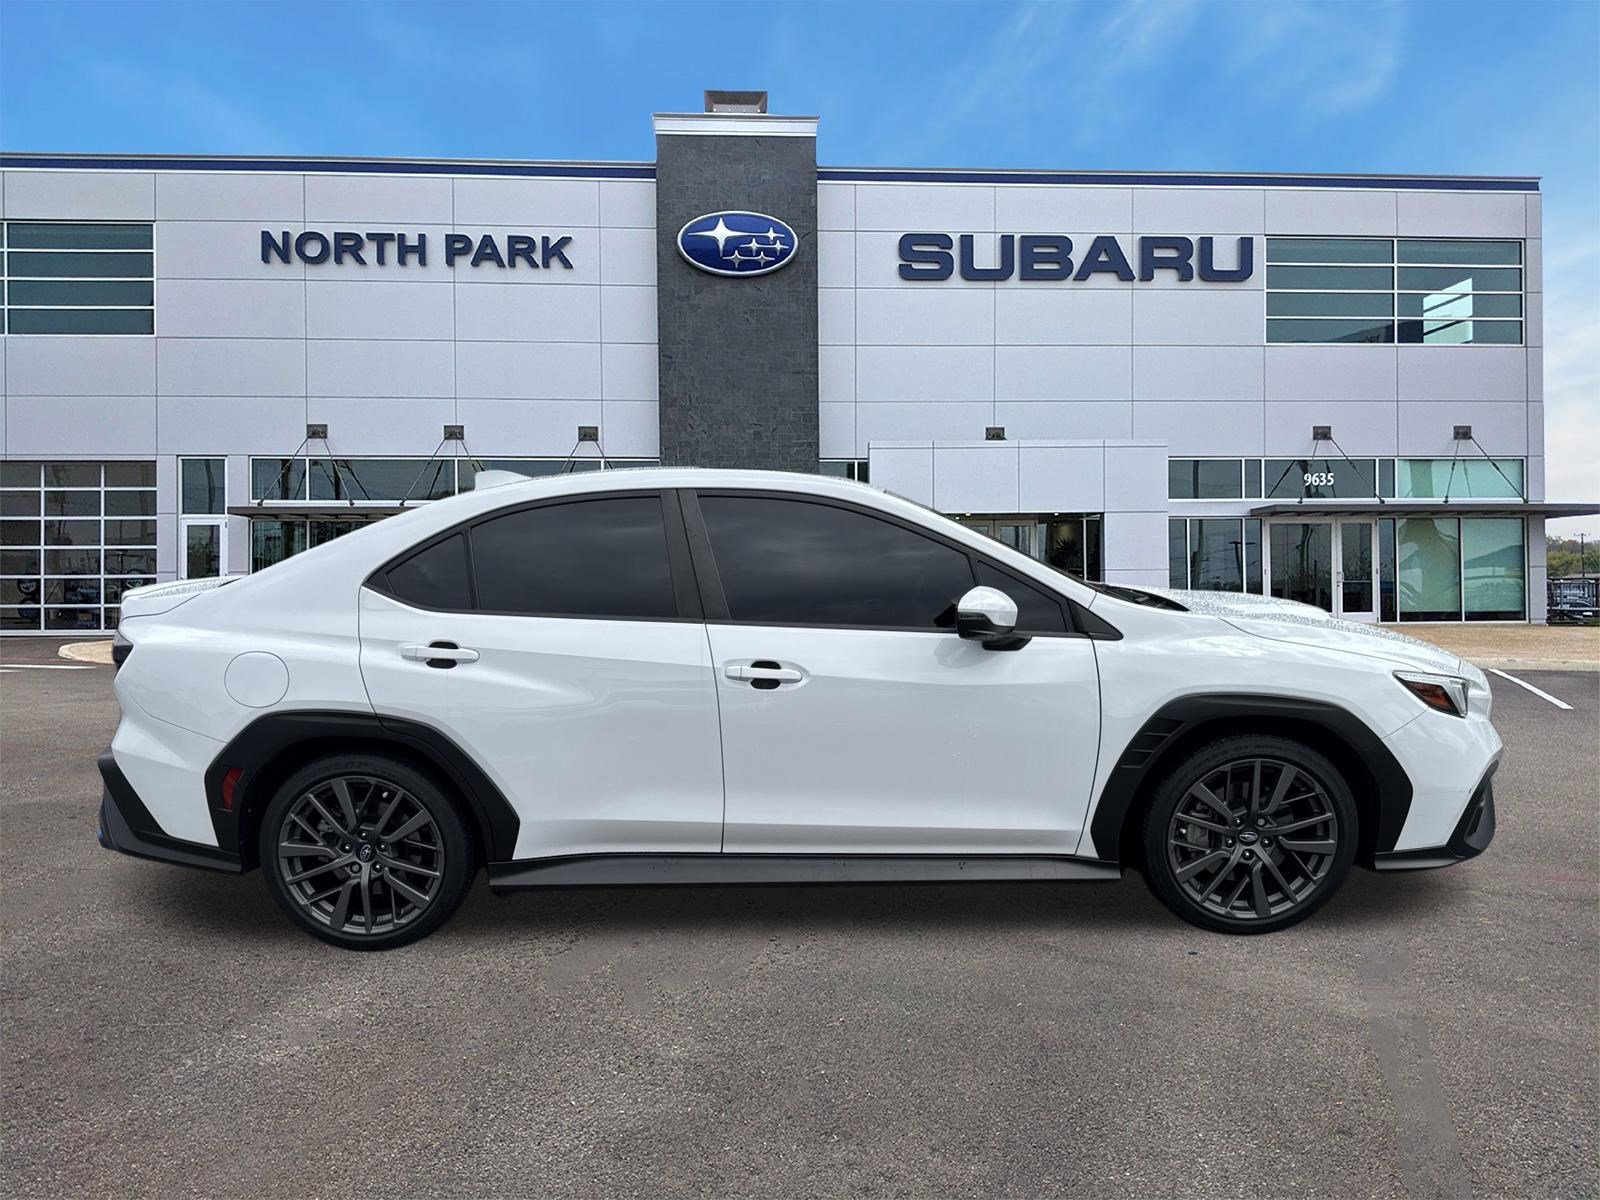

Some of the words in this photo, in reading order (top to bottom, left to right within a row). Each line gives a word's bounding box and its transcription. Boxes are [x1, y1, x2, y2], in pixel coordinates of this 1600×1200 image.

[261, 230, 427, 266] NORTH
[444, 233, 574, 269] PARK
[898, 232, 1254, 282] SUBARU
[1303, 472, 1335, 487] 9635
